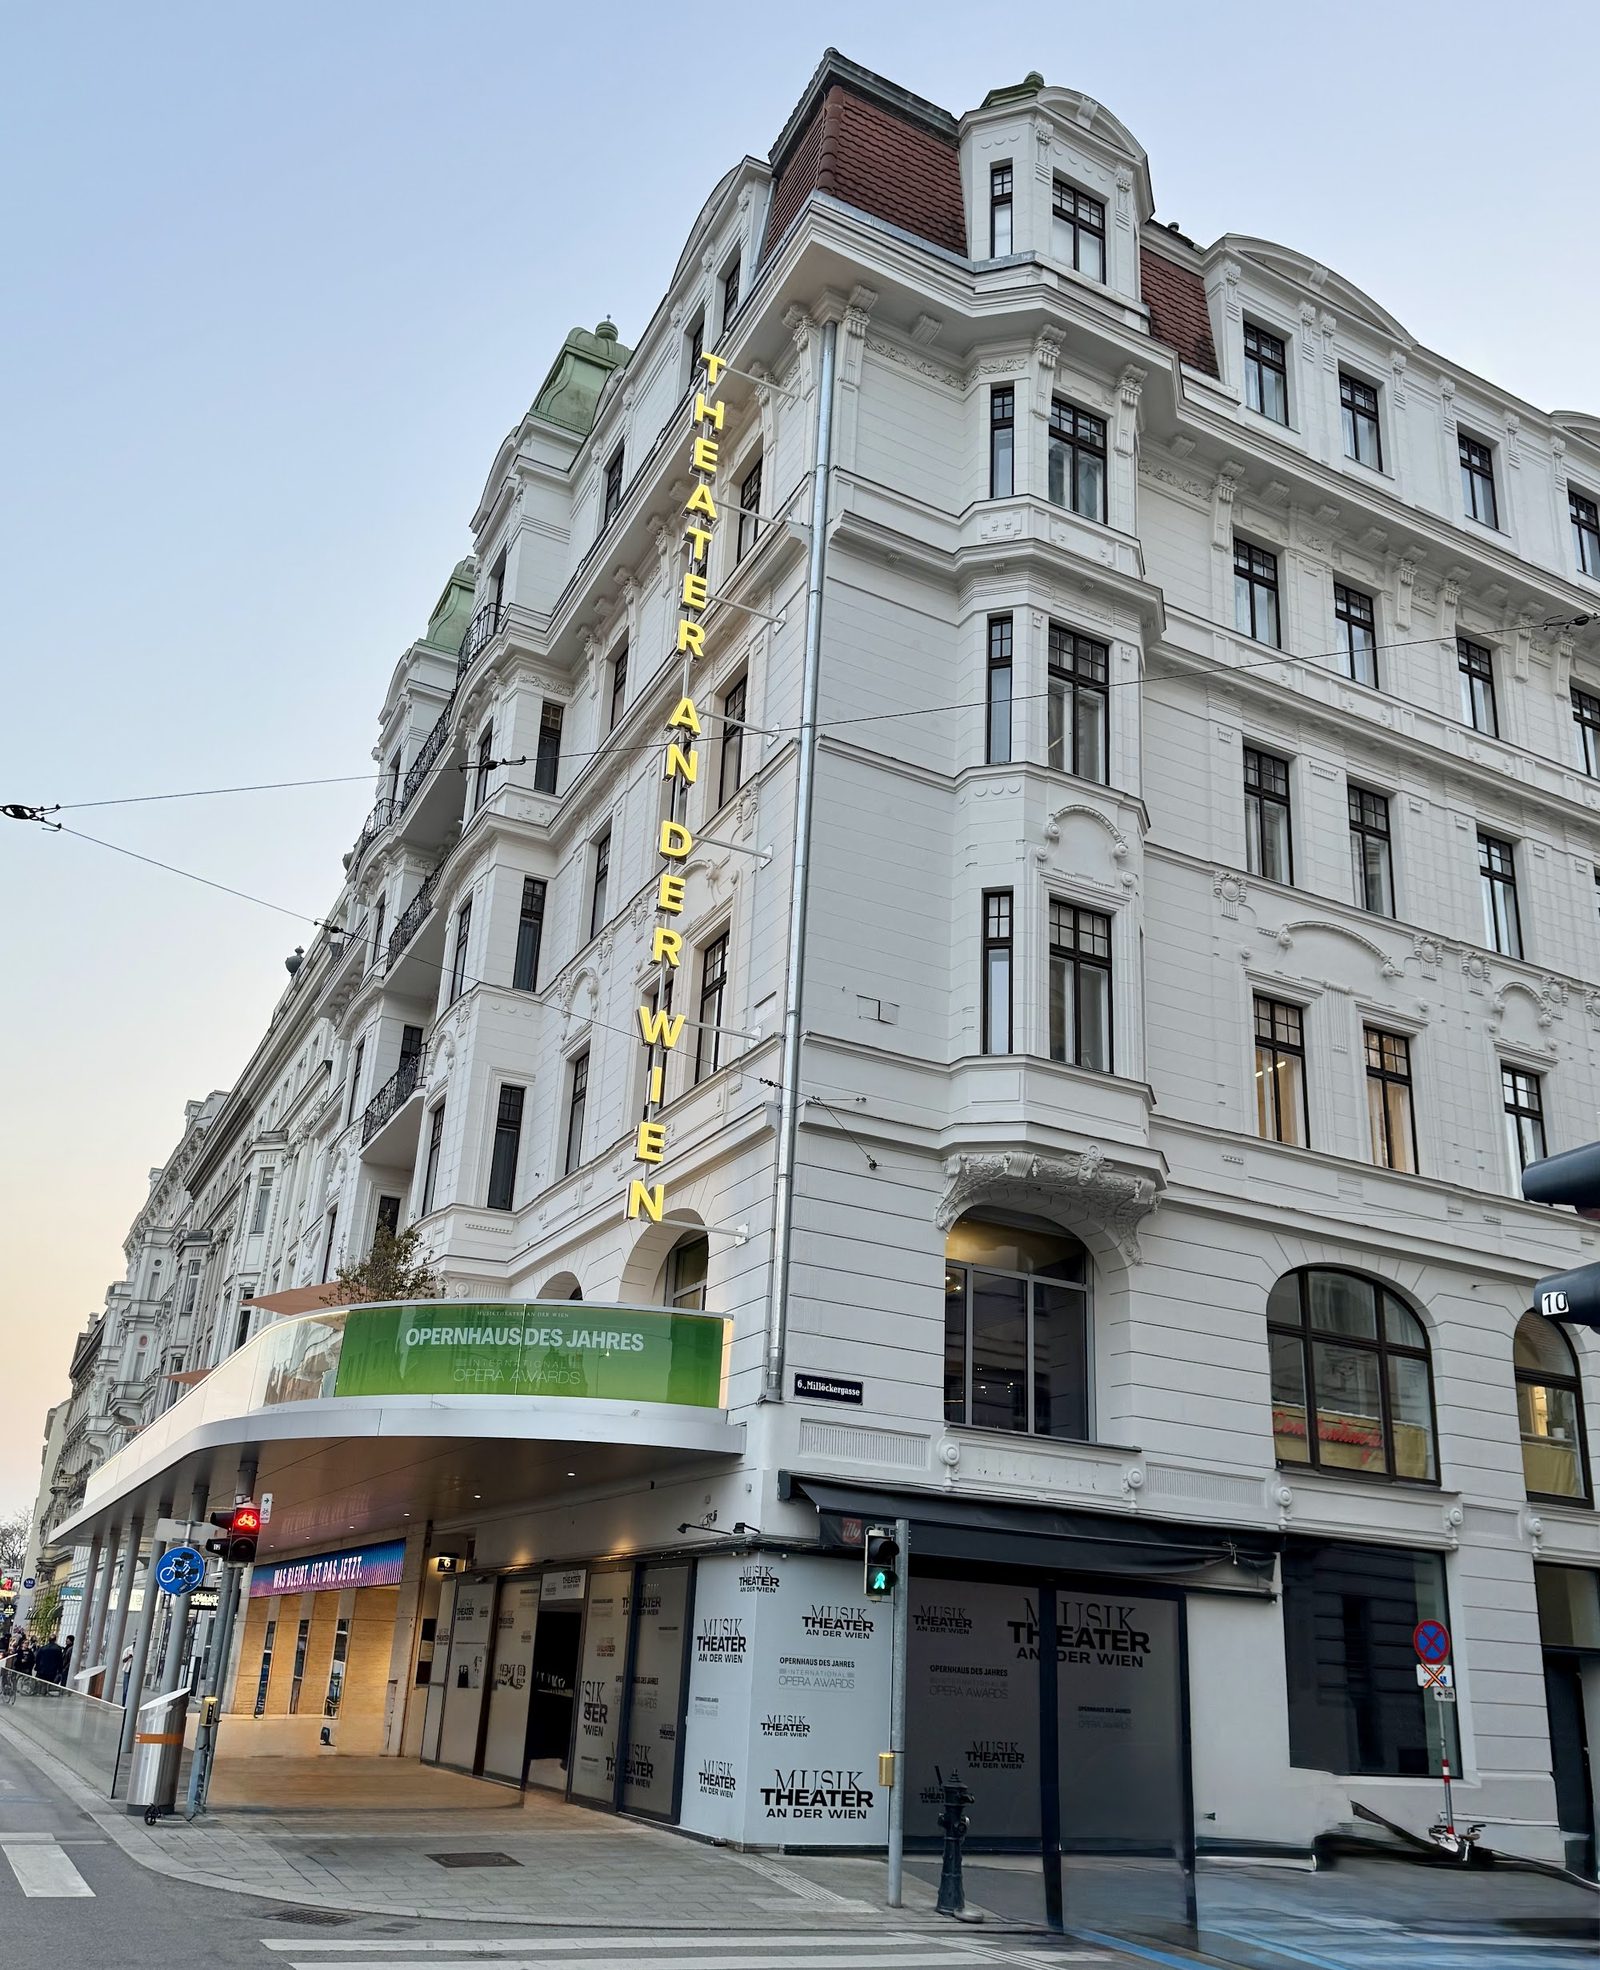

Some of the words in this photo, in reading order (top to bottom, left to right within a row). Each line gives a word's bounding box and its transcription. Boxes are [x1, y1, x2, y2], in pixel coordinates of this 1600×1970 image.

[676, 352, 726, 659] THEATER
[664, 697, 701, 785] AN
[652, 820, 692, 969] DER
[628, 1004, 686, 1223] WIEN
[1544, 1293, 1567, 1313] 10
[405, 1327, 521, 1346] OPERNHAUS
[524, 1328, 563, 1347] DES
[566, 1329, 644, 1351] JAHRES
[453, 1368, 505, 1384] OPERA
[509, 1369, 581, 1385] AWARDS
[806, 1380, 860, 1396] Millöckergasse
[273, 1569, 287, 1588] WAS
[310, 1562, 322, 1585] IST
[322, 1560, 337, 1583] DAS
[739, 1576, 780, 1588] THEATER
[811, 1604, 867, 1621] MUSIK
[921, 1605, 966, 1618] MUSIK
[703, 1618, 742, 1637] MUSIK
[801, 1616, 874, 1632] THEATER
[912, 1615, 972, 1629] THEATER
[845, 1631, 870, 1639] WIEN
[697, 1636, 746, 1652] THEATER
[698, 1653, 708, 1662] AN
[709, 1654, 723, 1662] DER
[724, 1654, 743, 1664] WIEN
[779, 1656, 818, 1666] OPERNHAUS
[818, 1659, 830, 1667] DES
[831, 1660, 855, 1668] JAHRES
[1097, 1652, 1143, 1668] WIEN
[929, 1664, 969, 1675] OPERNHAUS
[970, 1666, 982, 1676] DES
[984, 1668, 1008, 1677] JAHRES
[779, 1675, 811, 1686] OPERA
[813, 1678, 855, 1689] AWARDS
[929, 1685, 963, 1697] OPERA
[760, 1722, 811, 1732] THEATER
[767, 1714, 806, 1725] MUSIK
[973, 1741, 1019, 1754] MUSIK
[965, 1751, 1025, 1763] THEATER
[698, 1772, 736, 1790] THEATER
[775, 1769, 863, 1793] MUSIK
[700, 1785, 708, 1793] AN
[708, 1787, 719, 1796] DER
[719, 1789, 733, 1799] WIEN
[760, 1788, 874, 1808] THEATER
[766, 1808, 787, 1818] AN
[793, 1809, 823, 1819] DER
[828, 1809, 867, 1820] WIEN
